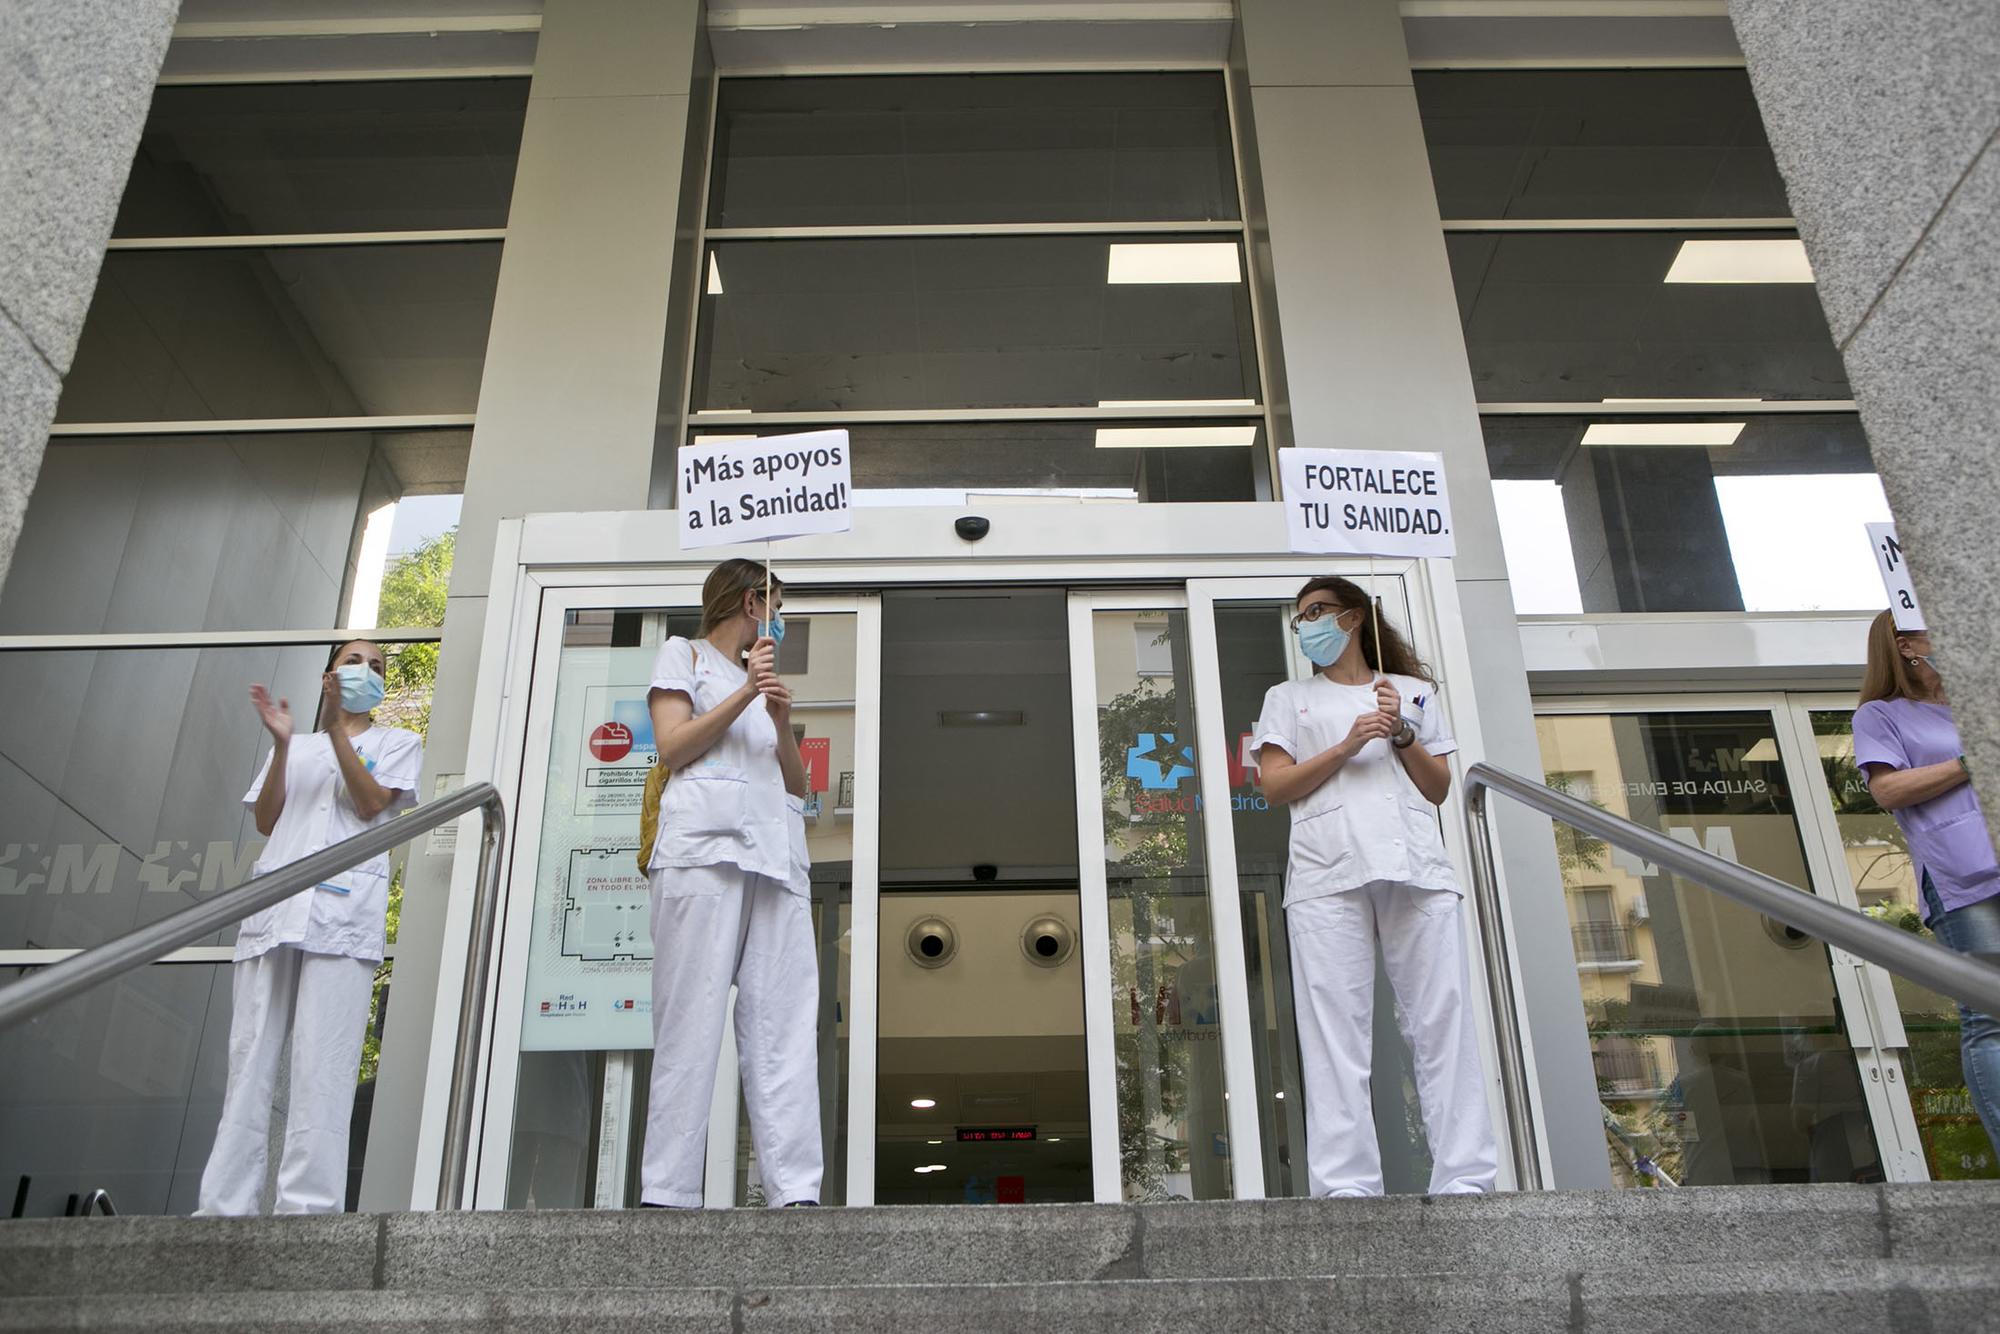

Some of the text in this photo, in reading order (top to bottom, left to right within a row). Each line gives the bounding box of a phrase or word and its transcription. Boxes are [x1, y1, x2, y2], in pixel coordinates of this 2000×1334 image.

[685, 447, 843, 494] ¡Más apoyos
[1305, 464, 1438, 496] FORTALECE
[689, 482, 847, 530] a la Sanidad!
[1300, 503, 1449, 535] TU SANIDAD.
[1897, 589, 1915, 610] a
[598, 777, 632, 785] cigarrillos
[586, 876, 607, 884] ZONA
